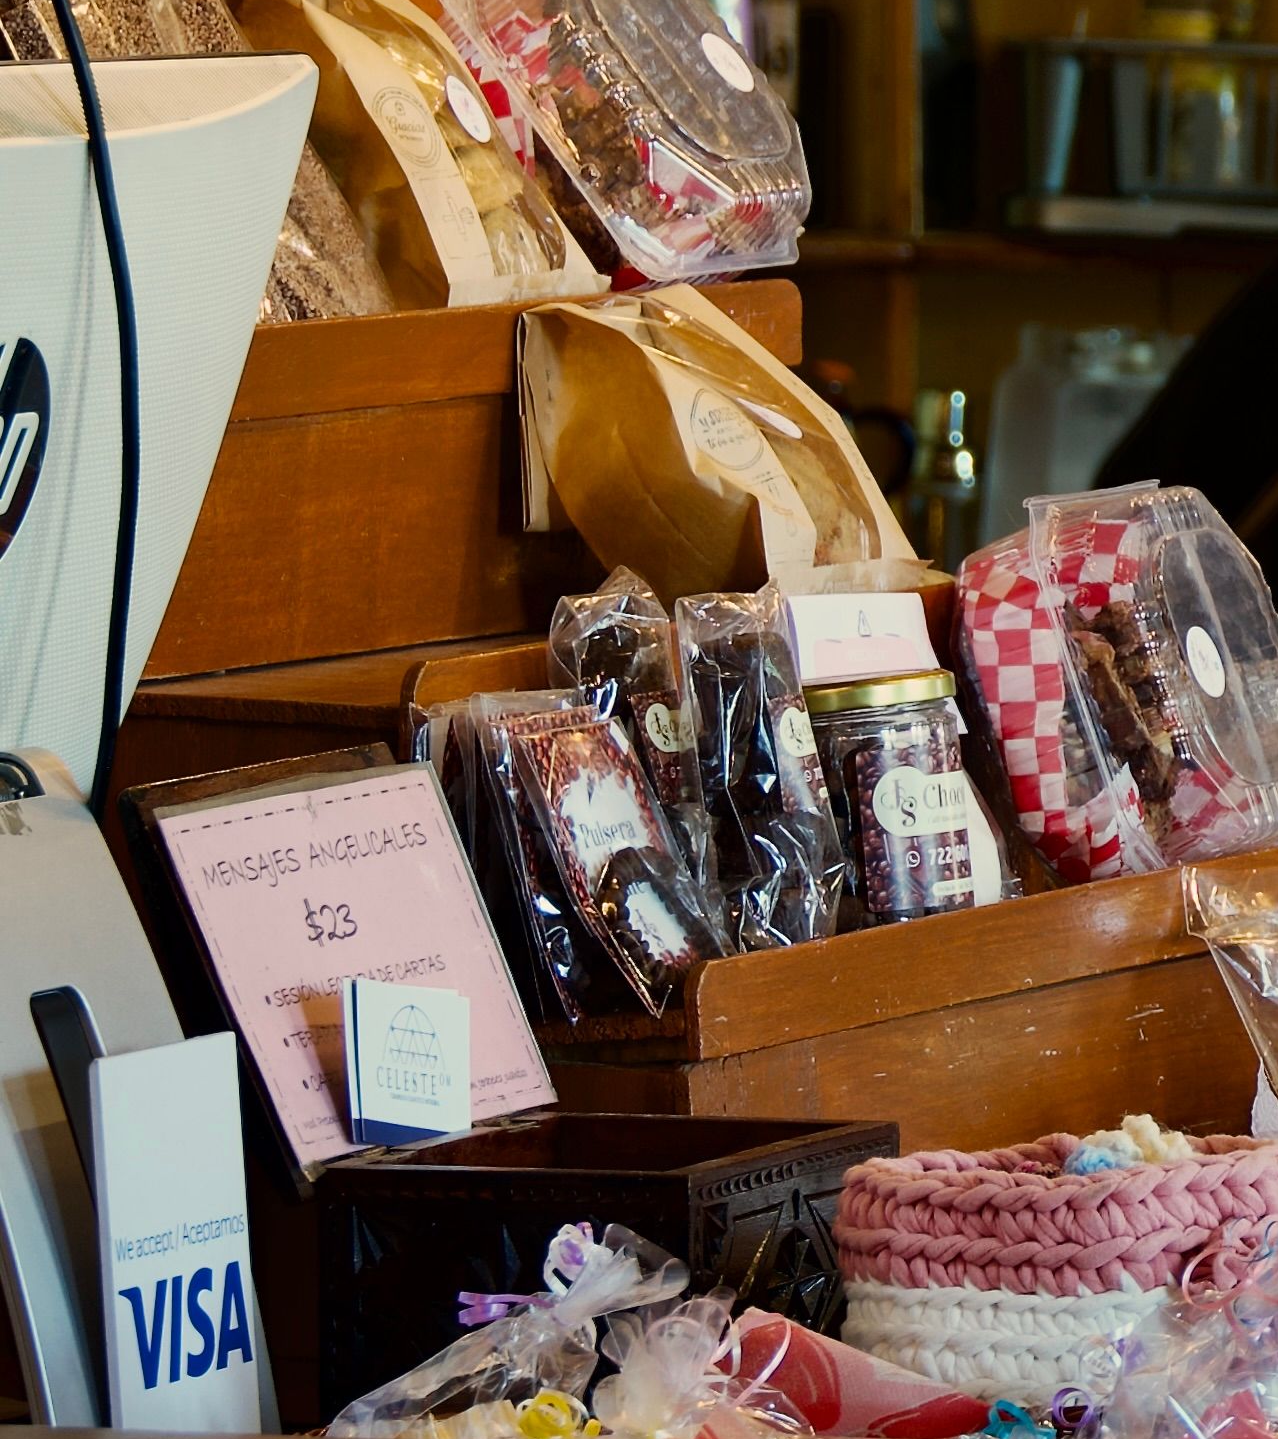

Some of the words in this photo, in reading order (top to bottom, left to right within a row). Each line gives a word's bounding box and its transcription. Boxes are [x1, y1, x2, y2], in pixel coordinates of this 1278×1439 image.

[202, 847, 301, 889] MENSAJES
[308, 822, 428, 869] ANGELICALES
[579, 820, 637, 849] Pulsera
[303, 897, 358, 948] $23
[394, 953, 447, 982] CARTAS
[376, 1065, 437, 1097] CELESTE
[115, 1236, 134, 1262] We
[135, 1230, 174, 1257] accept
[182, 1213, 246, 1248] Aceptamos
[118, 1260, 254, 1390] VISA
